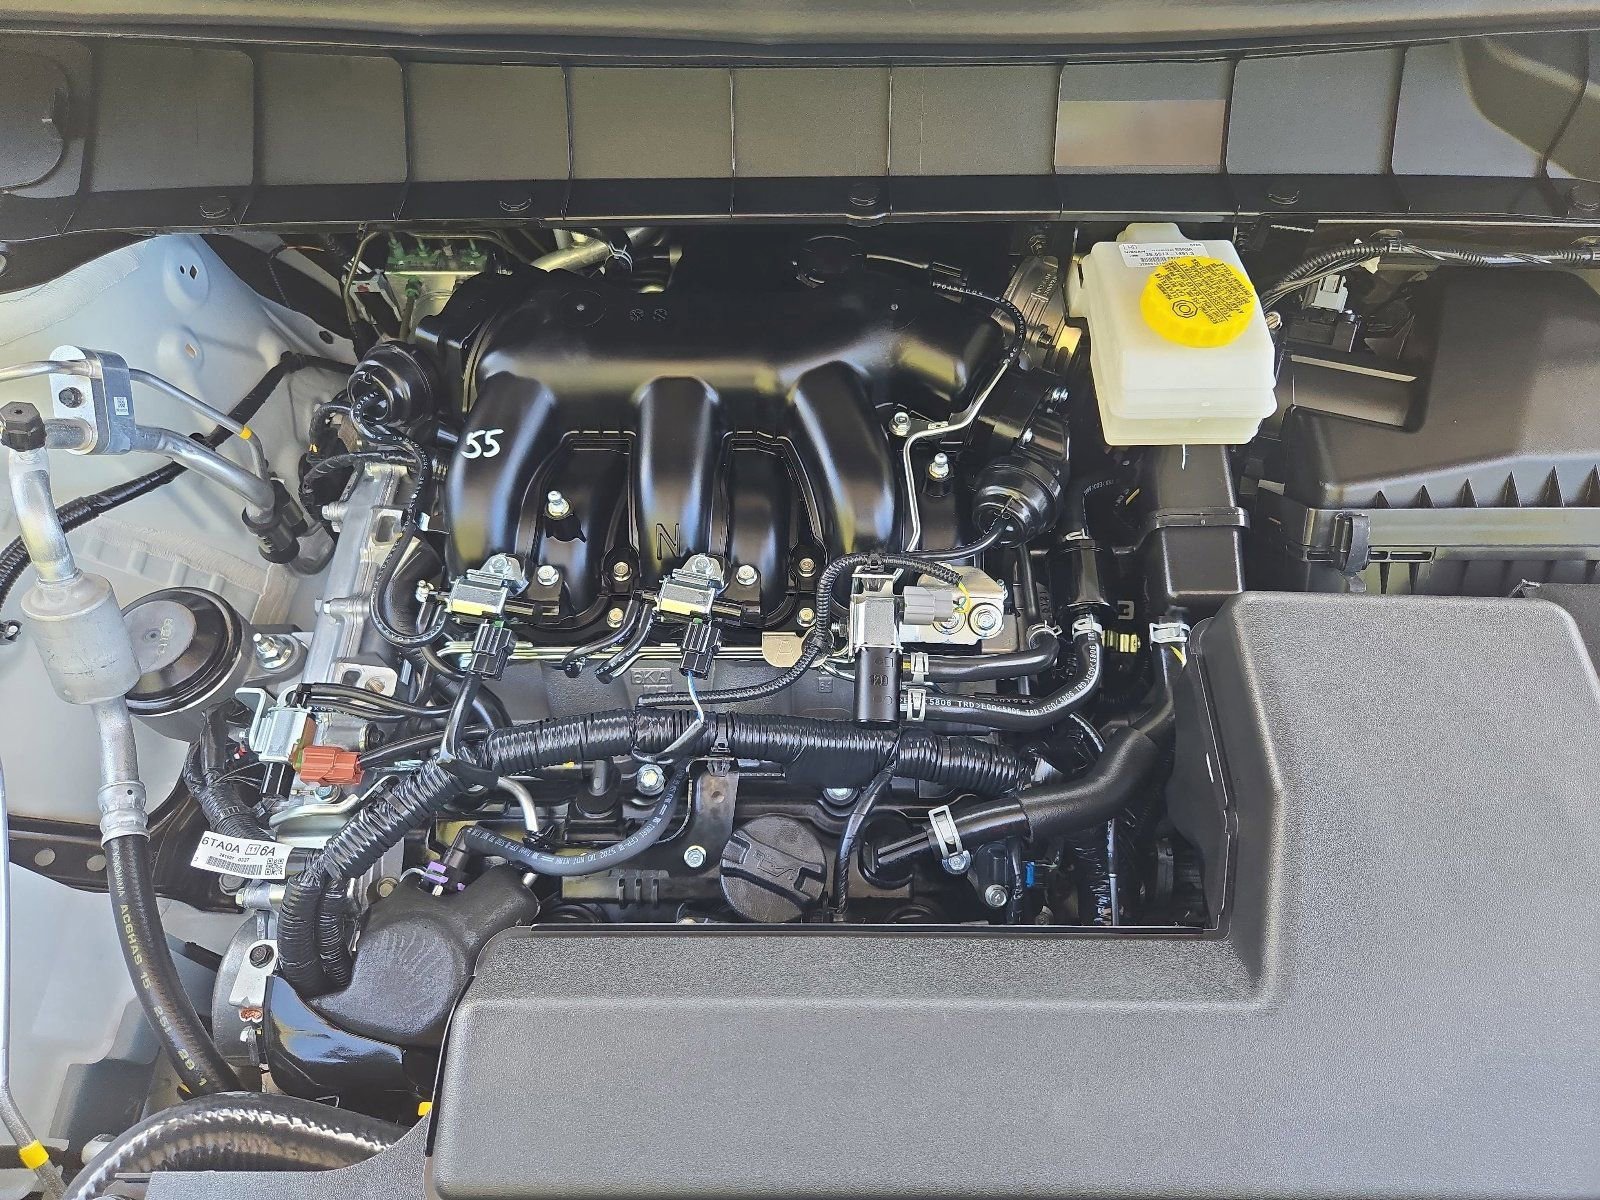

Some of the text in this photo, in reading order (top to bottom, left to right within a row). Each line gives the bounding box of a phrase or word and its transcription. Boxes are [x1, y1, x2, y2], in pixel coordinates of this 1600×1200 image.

[460, 428, 504, 459] 55
[655, 522, 681, 561] N
[260, 845, 276, 857] 6A
[140, 971, 152, 990] 15
